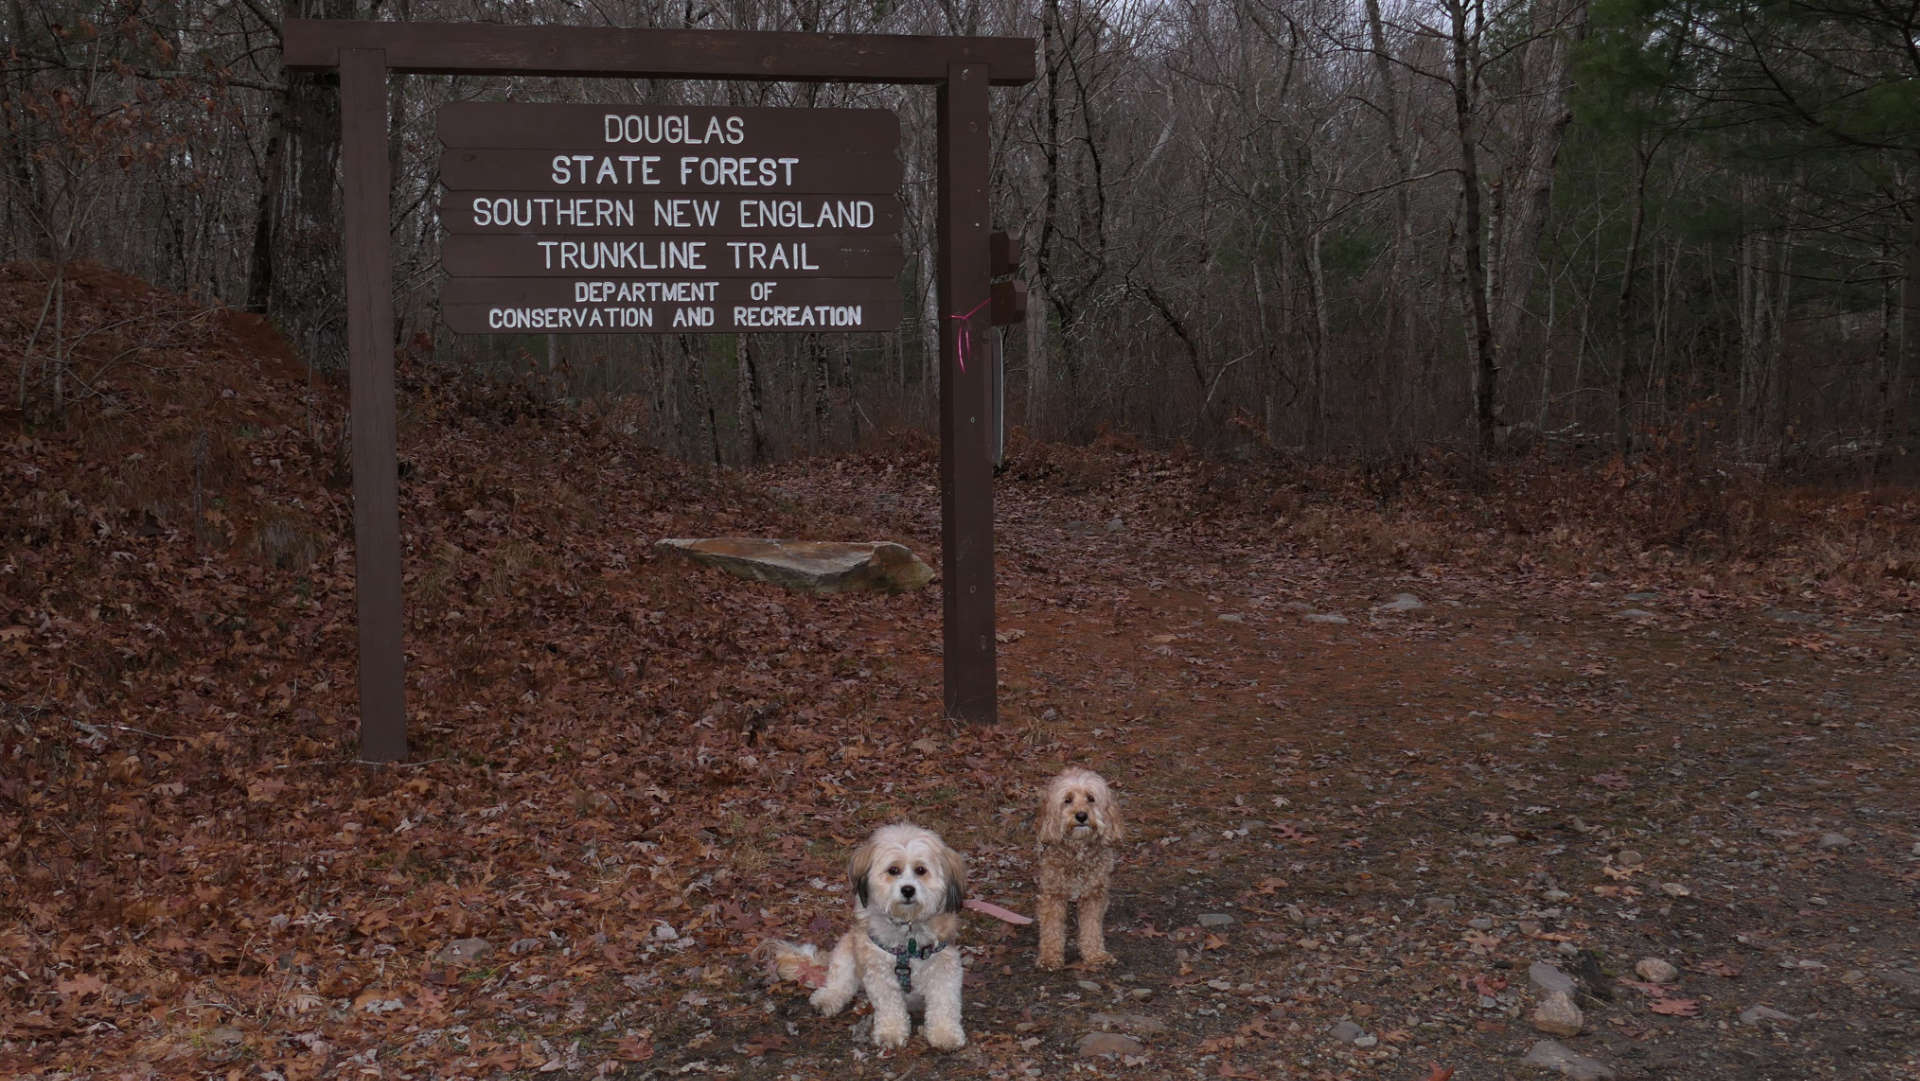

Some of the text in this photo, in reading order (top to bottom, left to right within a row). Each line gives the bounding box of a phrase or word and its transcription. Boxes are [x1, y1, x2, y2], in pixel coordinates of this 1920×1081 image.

[604, 114, 745, 145] DOUGLAS
[551, 154, 800, 187] STATE FOREST
[472, 197, 874, 229] SOUTHERN NEW ENGLAND
[536, 240, 820, 271] TRUNKLINE TRAIL
[574, 281, 778, 303] DEPARTMENT OF
[488, 305, 862, 329] CONSERVATION AND RECREATION
